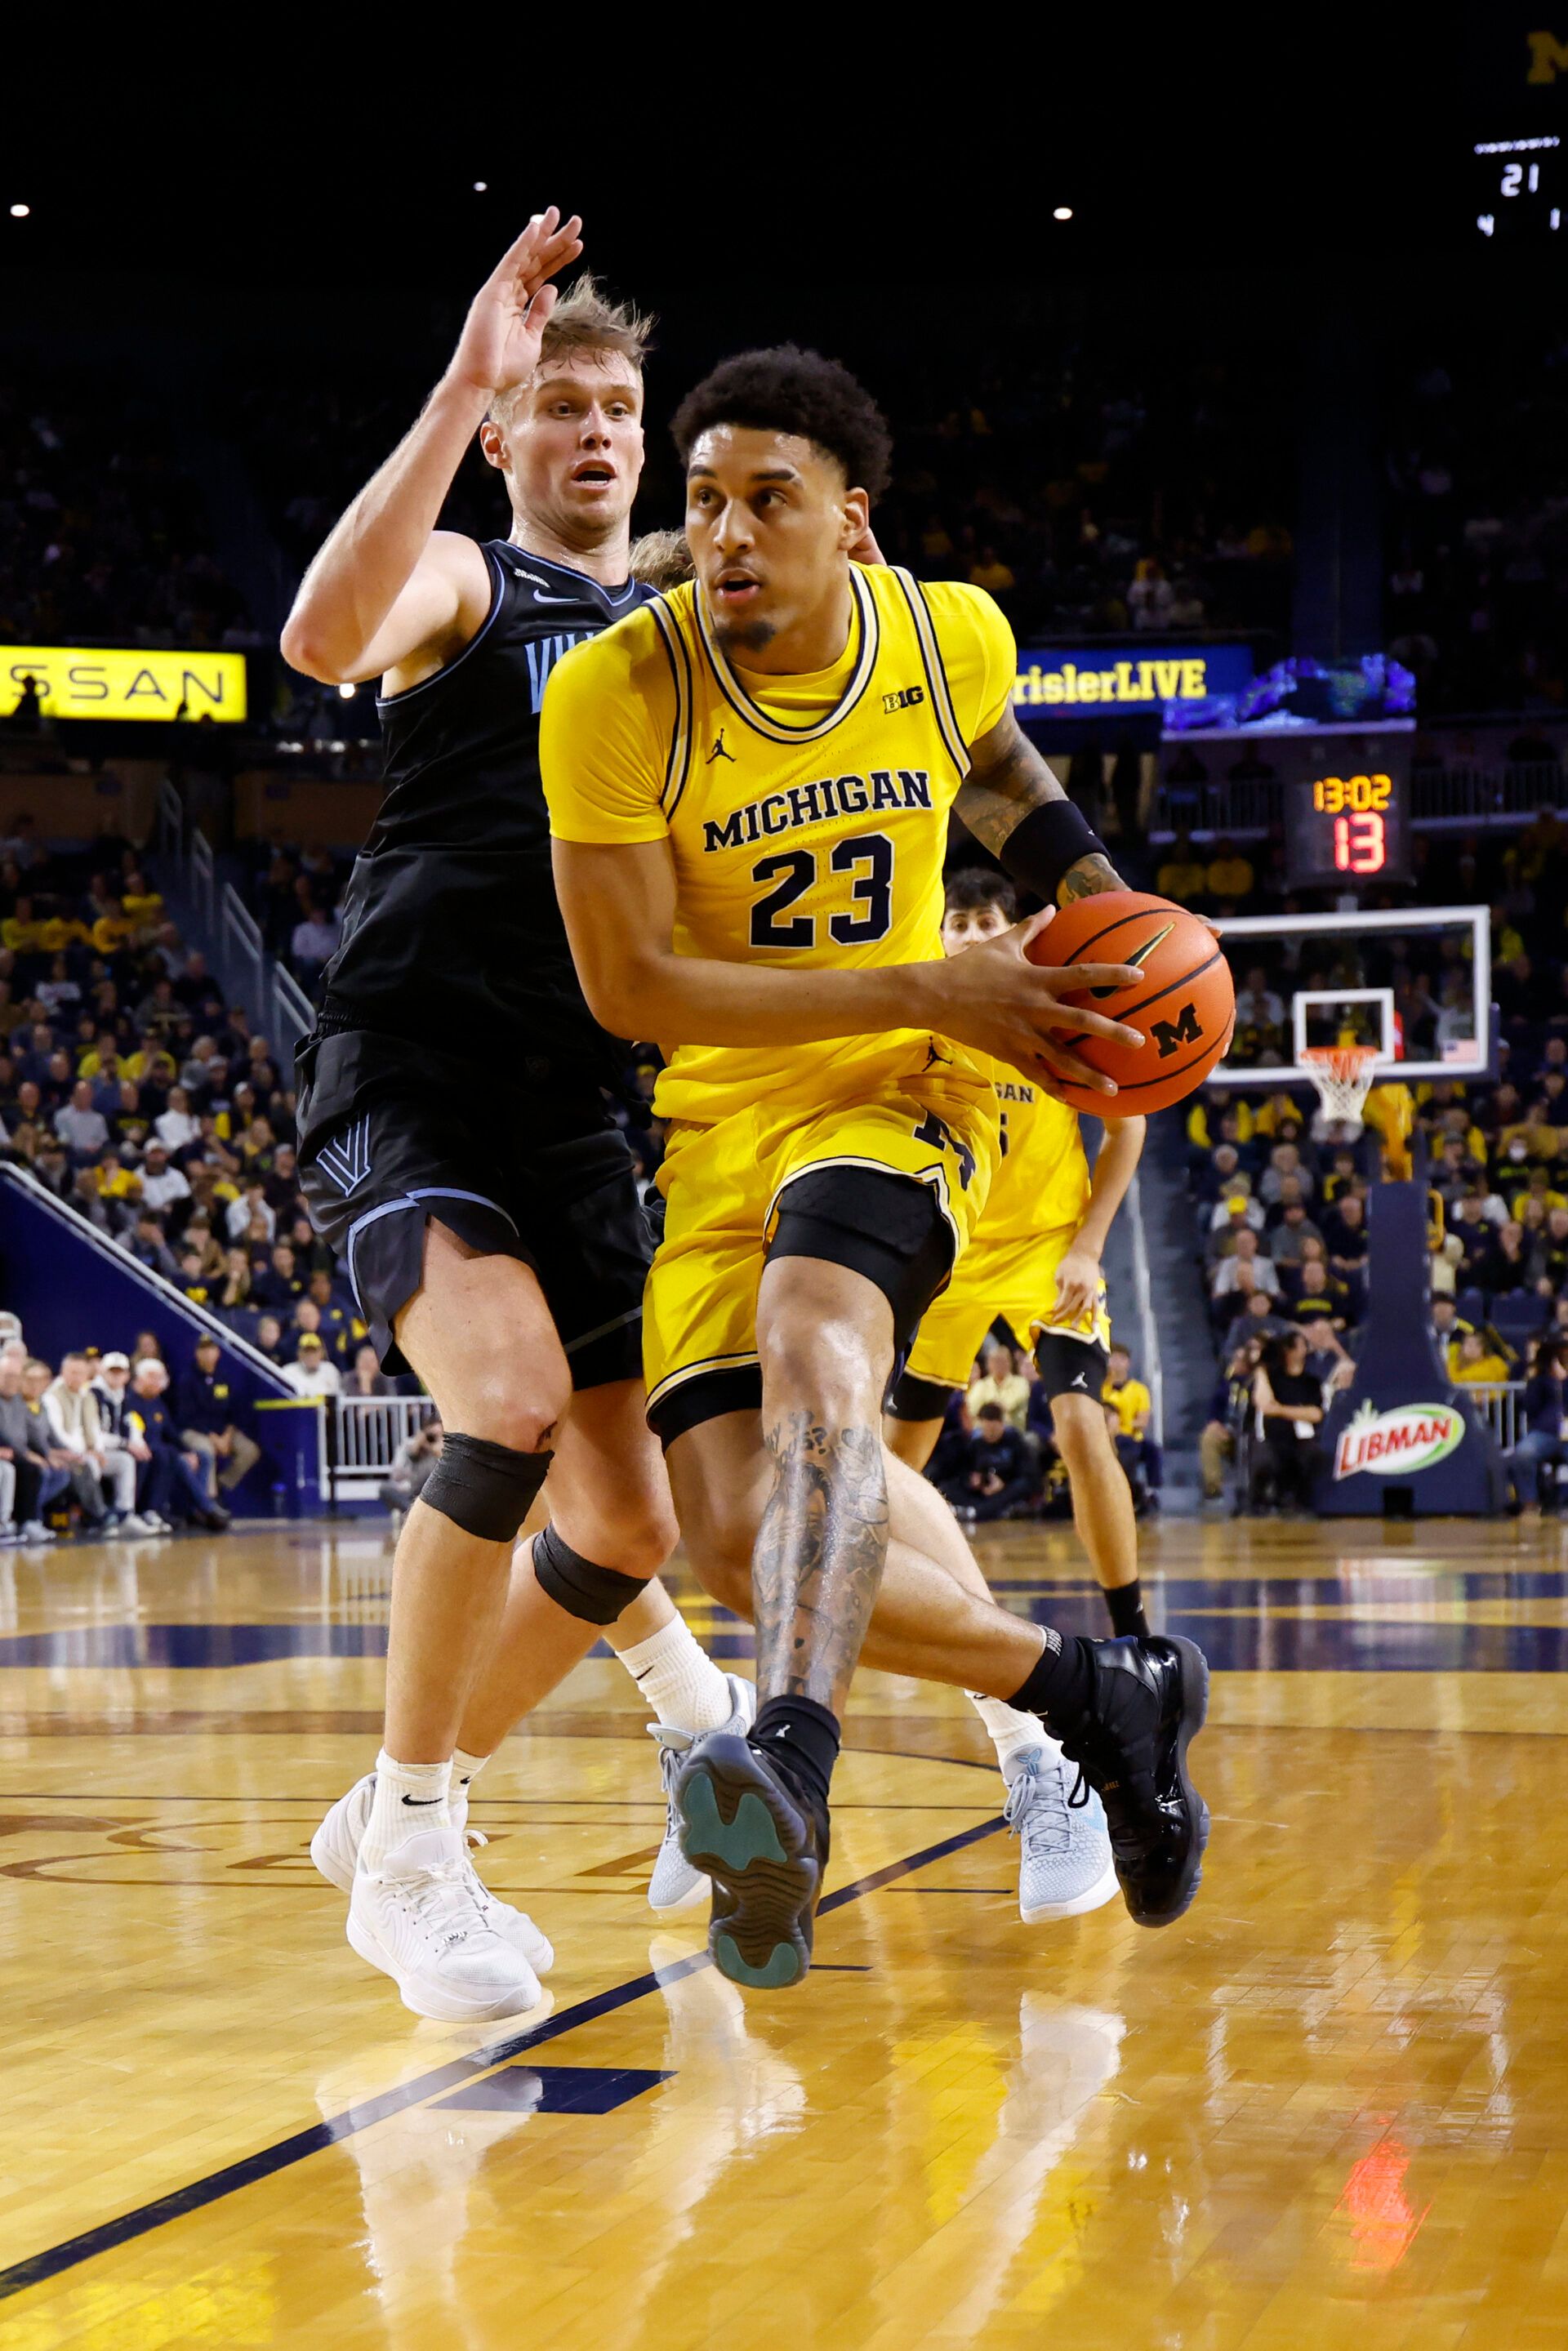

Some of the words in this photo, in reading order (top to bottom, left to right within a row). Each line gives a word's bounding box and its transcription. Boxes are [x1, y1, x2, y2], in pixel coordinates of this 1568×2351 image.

[1500, 163, 1539, 197] 21
[703, 770, 933, 853] MICHIGAN
[1312, 773, 1392, 814] 13:02
[1334, 811, 1386, 874] 13
[749, 831, 896, 948] 23
[1151, 1003, 1205, 1059] M
[1340, 1417, 1452, 1472] LIBMAN
